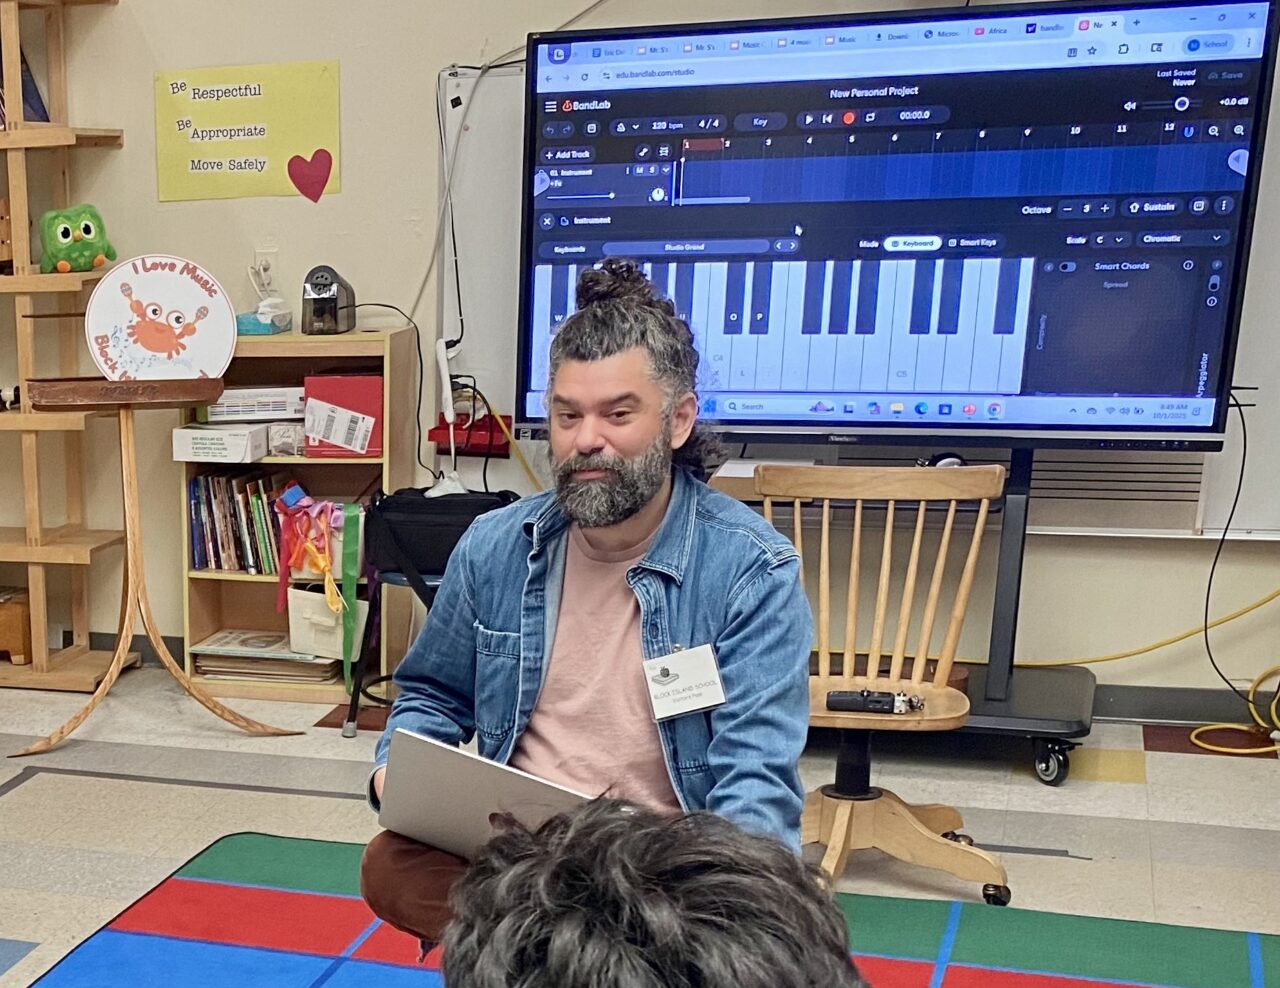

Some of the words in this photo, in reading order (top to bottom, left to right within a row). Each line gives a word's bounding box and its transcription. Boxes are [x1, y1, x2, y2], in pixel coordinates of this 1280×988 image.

[1203, 40, 1228, 48] School
[616, 67, 695, 79] edu.bandlab.com/studio
[1157, 70, 1172, 78] Last
[1173, 69, 1196, 77] Saved
[1173, 79, 1196, 87] Never
[170, 81, 187, 95] Be
[192, 84, 262, 100] Respectful
[830, 89, 850, 98] New
[851, 87, 888, 97] Personal
[889, 86, 919, 97] Project
[573, 100, 611, 110] BandLab
[652, 121, 667, 130] 120
[668, 122, 684, 130] bpm
[753, 118, 768, 127] Key
[176, 119, 192, 131] Be
[191, 125, 266, 140] Appropriate
[725, 140, 731, 148] 2
[765, 138, 772, 146] 3
[807, 136, 813, 144] 4
[849, 135, 855, 143] 5
[936, 132, 942, 140] 7
[979, 130, 986, 138] 8
[1024, 128, 1031, 136] 9
[1070, 126, 1081, 134] 10
[1117, 124, 1127, 133] 11
[1164, 123, 1175, 131] 12
[572, 150, 590, 158] Track
[190, 160, 223, 171] Move
[228, 159, 266, 173] Safely
[1022, 206, 1052, 215] Octave
[1083, 204, 1091, 213] 3
[1143, 203, 1175, 211] Sustain
[573, 216, 611, 224] Instrument
[1096, 236, 1104, 244] C
[1143, 234, 1181, 243] Chromatic
[859, 240, 880, 248] Mode
[903, 240, 934, 248] Keyboard
[960, 239, 979, 247] Smart
[980, 239, 997, 248] Keys
[1094, 263, 1120, 271] Smart
[1121, 262, 1150, 271] Chords
[132, 262, 139, 275] I
[141, 258, 177, 273] Love
[179, 261, 218, 298] Music
[555, 314, 564, 322] W
[729, 313, 738, 321] O
[757, 313, 763, 321] P
[94, 334, 118, 375] Block
[1196, 352, 1209, 398] Arpeggiator
[741, 403, 764, 411] Search
